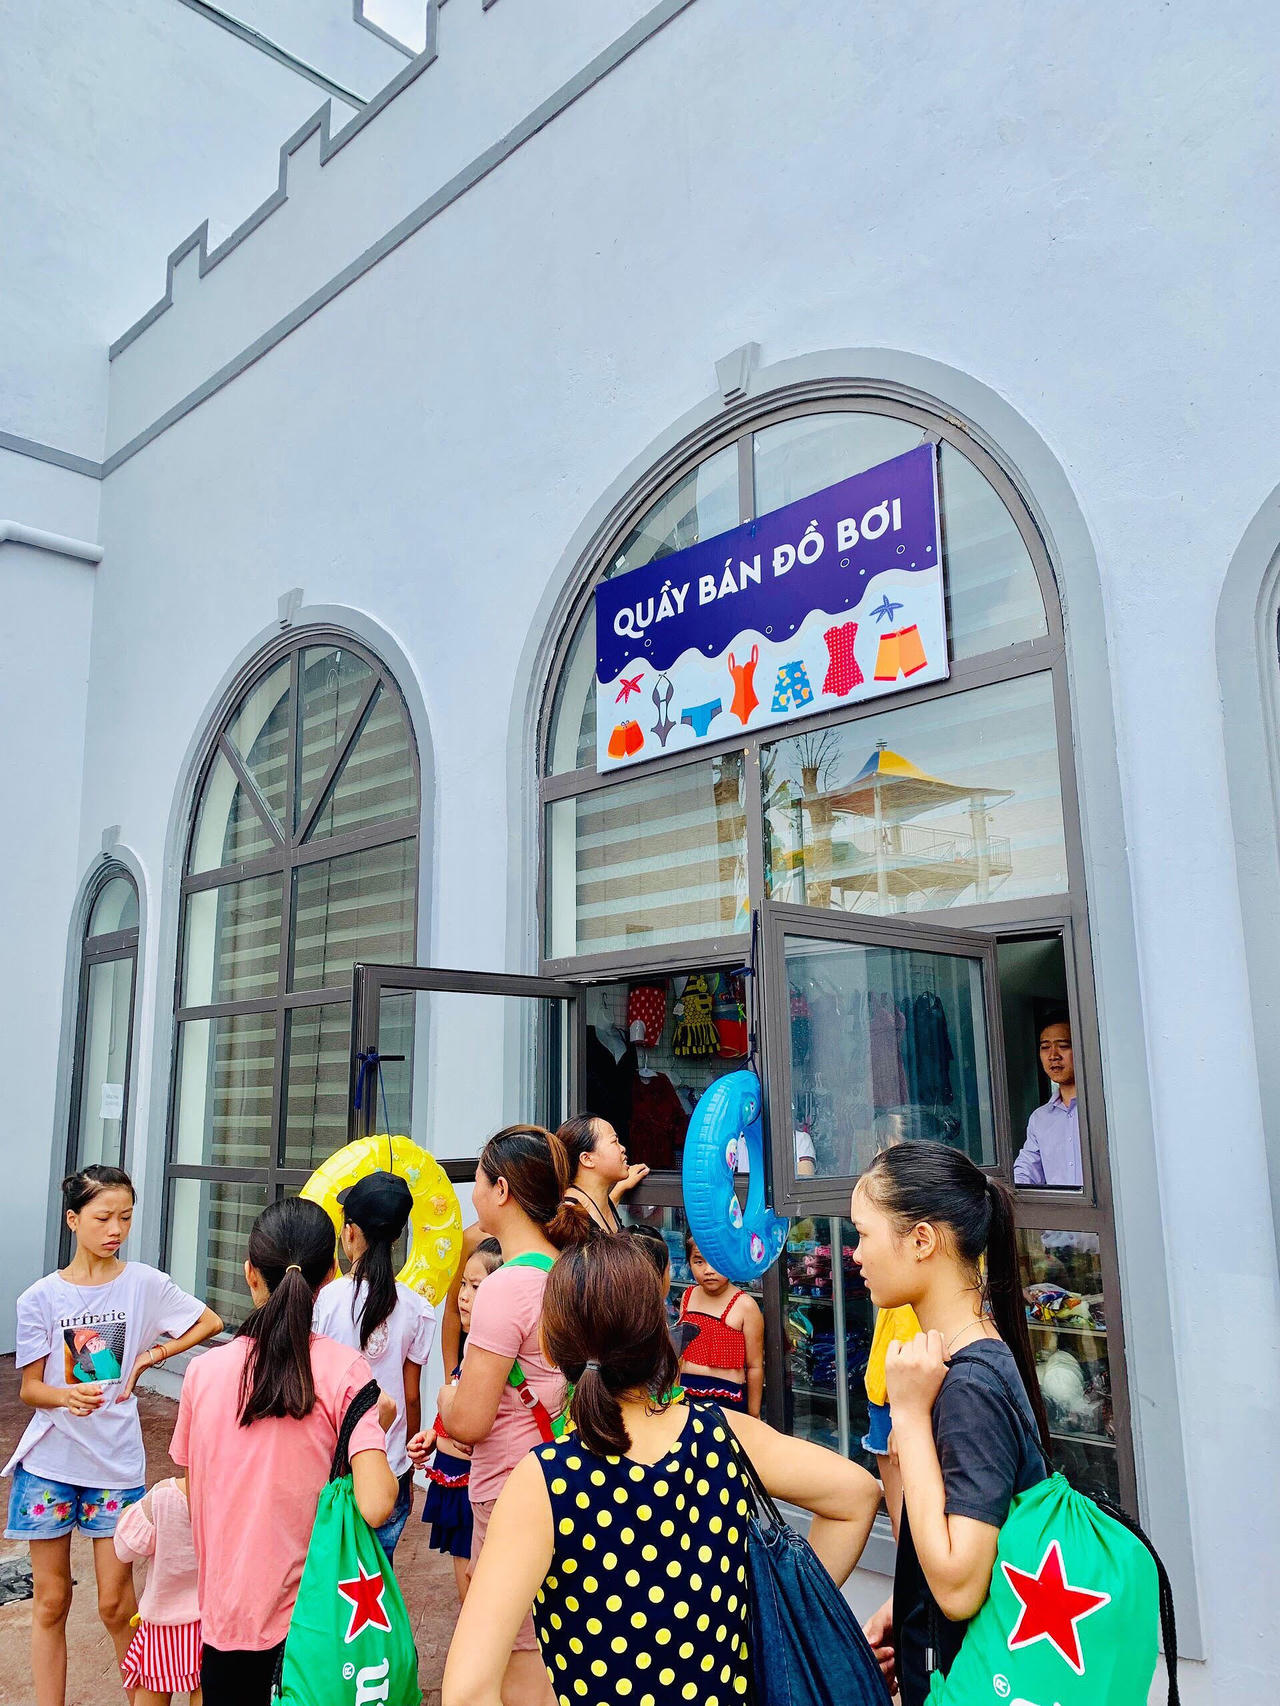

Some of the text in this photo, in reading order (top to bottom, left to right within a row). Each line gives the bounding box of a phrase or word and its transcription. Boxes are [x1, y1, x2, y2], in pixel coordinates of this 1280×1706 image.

[613, 497, 902, 638] QUẦY BÁN ĐỒ BƠI
